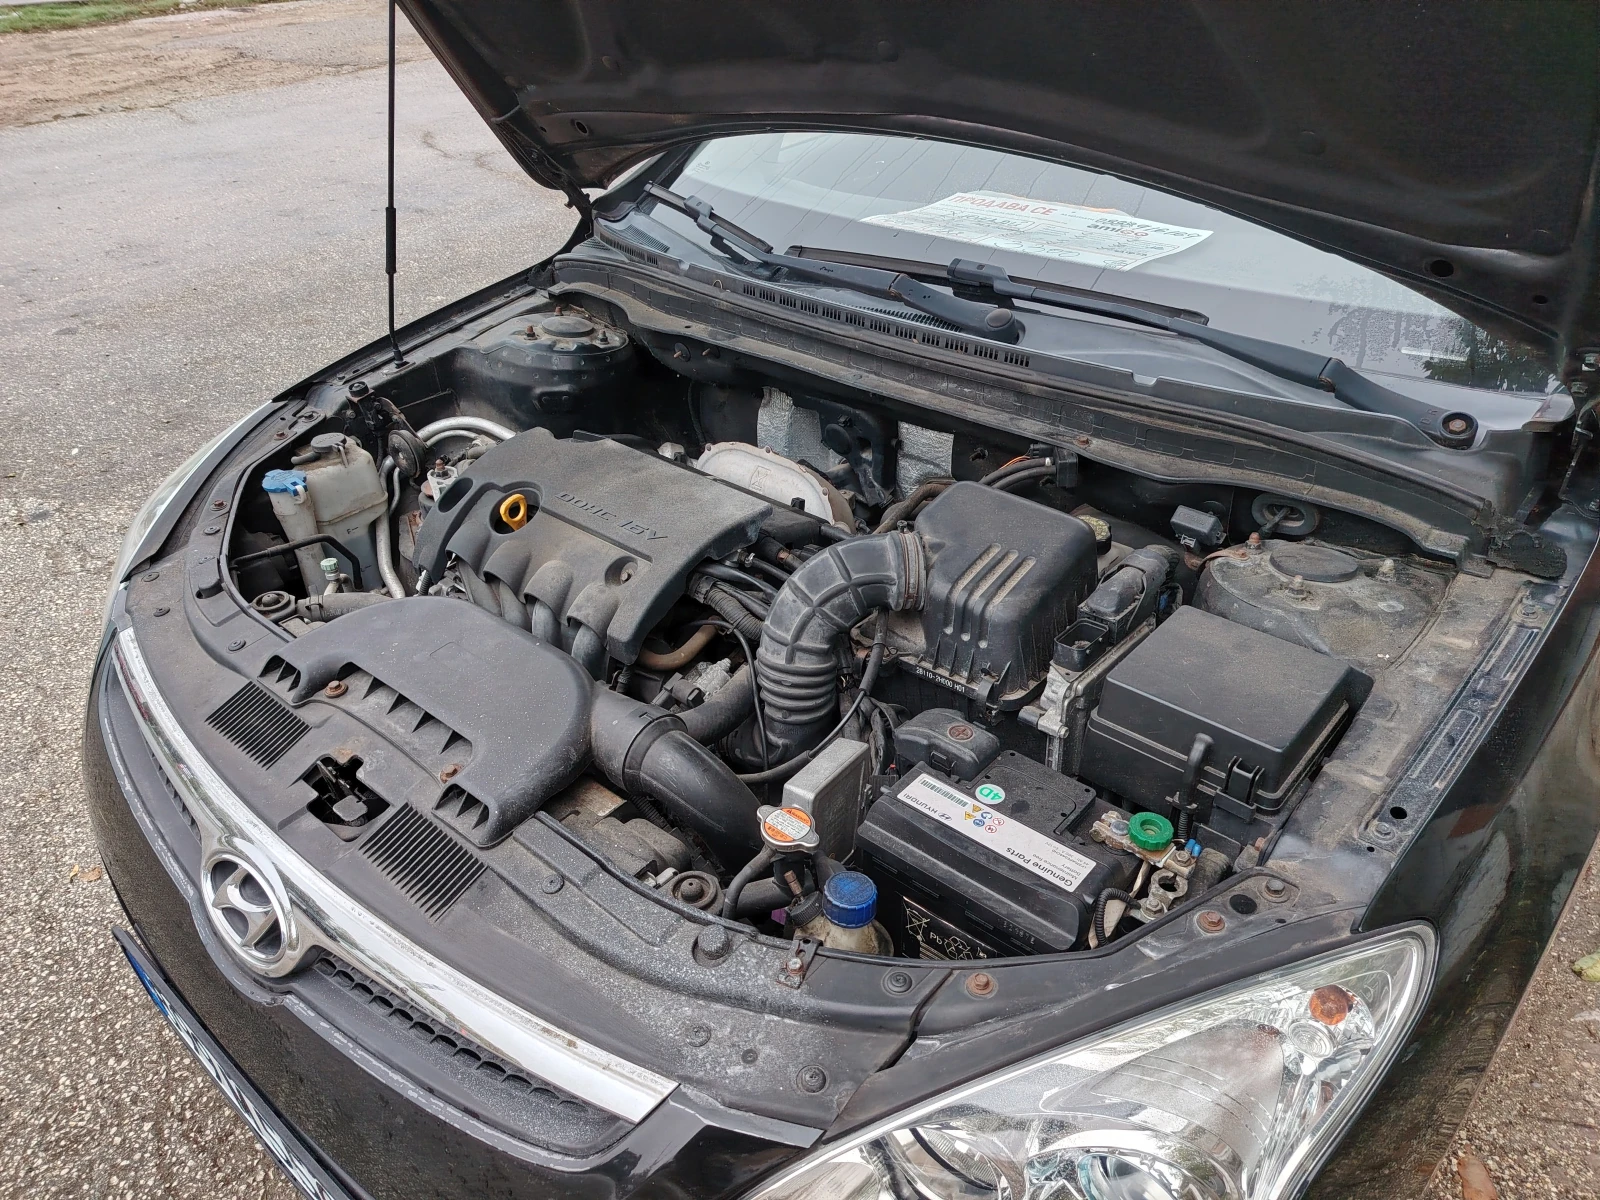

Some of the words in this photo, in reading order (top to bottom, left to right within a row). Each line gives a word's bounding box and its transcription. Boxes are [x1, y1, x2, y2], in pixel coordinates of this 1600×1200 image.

[951, 196, 1029, 212] ПРОДАВА
[1030, 206, 1058, 216] СЕ
[555, 493, 617, 521] DOHC
[618, 520, 668, 540] 16V
[904, 793, 938, 814] HYUNDAI
[978, 786, 1002, 801] 4D
[1006, 847, 1031, 864] Parts
[1032, 861, 1073, 887] Genuine
[930, 931, 943, 945] Pb
